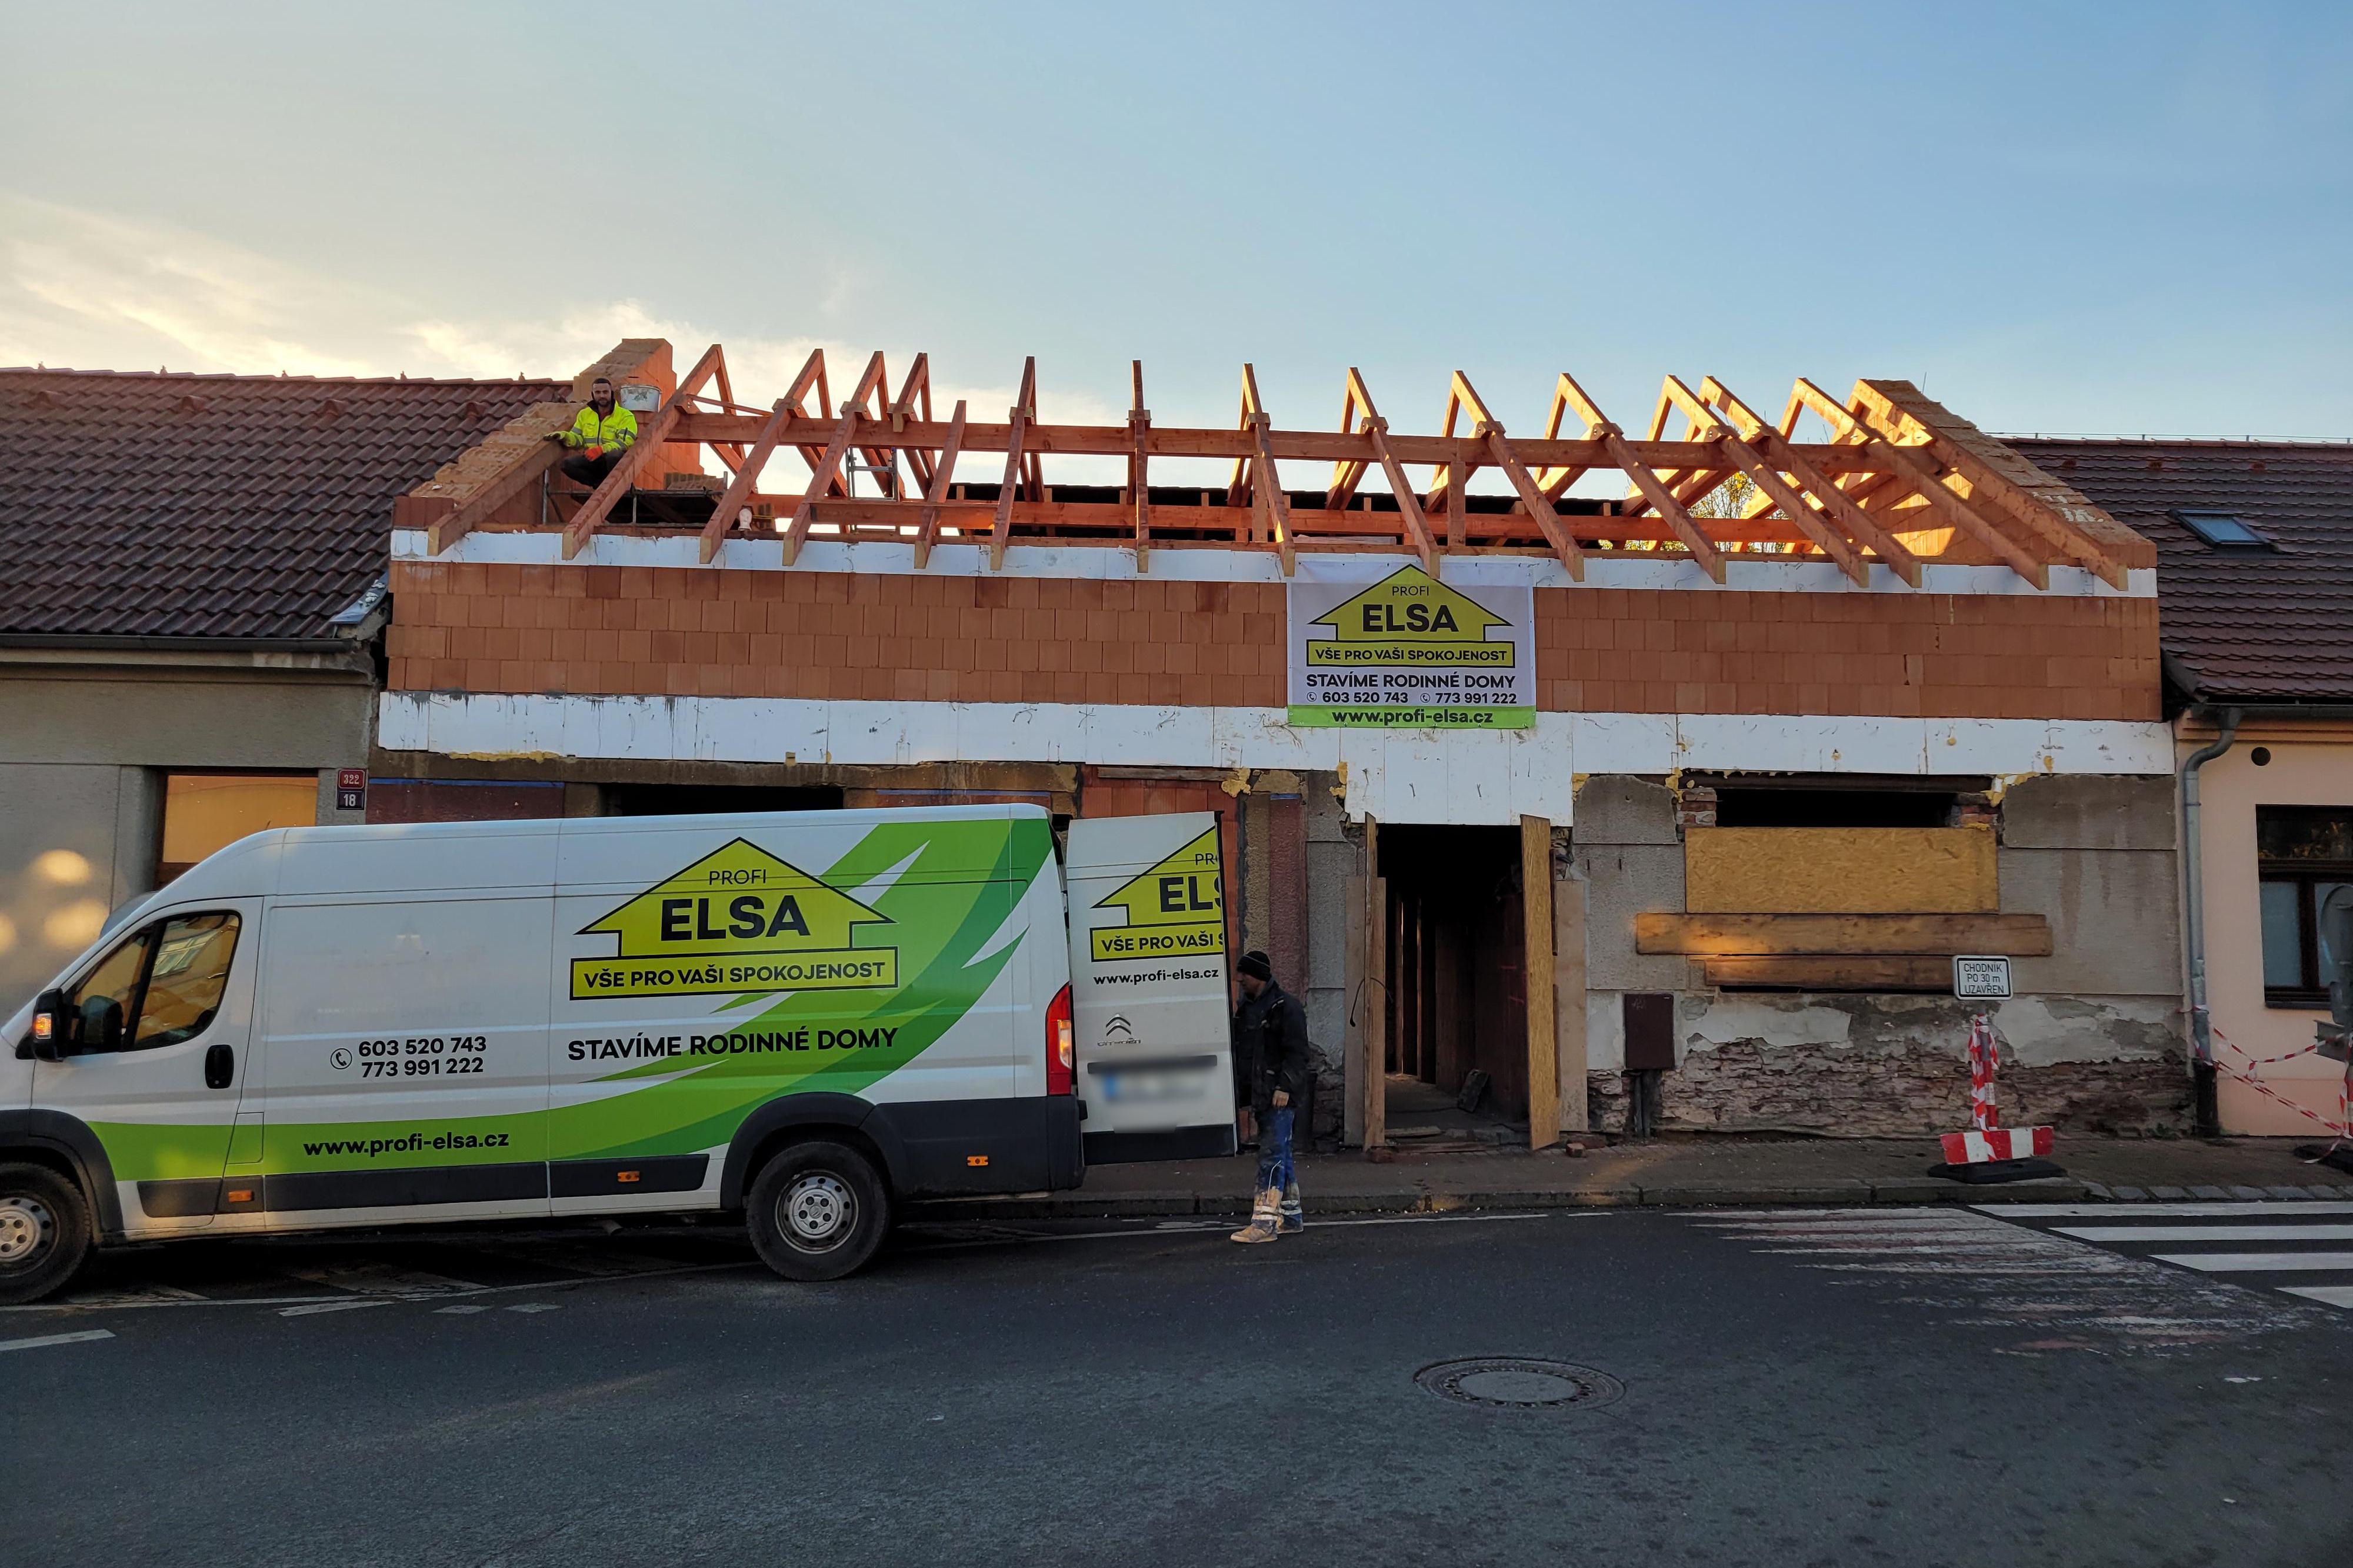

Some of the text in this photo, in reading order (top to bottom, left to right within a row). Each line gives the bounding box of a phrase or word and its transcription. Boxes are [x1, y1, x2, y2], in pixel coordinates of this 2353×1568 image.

[1392, 586, 1429, 596] PROFI
[1362, 603, 1459, 632] ELSA
[1315, 647, 1507, 661] VŠE PRO VAŠI SPOKOJENOST
[1307, 672, 1515, 688] STAVÍME RODINNÉ DOMY
[1322, 692, 1517, 704] 603 520 743 773 991 222
[1332, 709, 1493, 725] www.profi-elsa.cz
[344, 775, 359, 784] 322
[344, 794, 356, 806] 18
[1195, 853, 1217, 865] PR
[709, 869, 766, 886] PROFI
[1159, 876, 1221, 912] EL
[661, 895, 811, 941] ELSA
[1101, 935, 1134, 952] VŠE
[1139, 936, 1174, 950] PRO
[1176, 930, 1214, 948] VAŠI
[584, 962, 885, 988] VŠE PRO VAŠI SPOKOJENOST
[1094, 968, 1219, 985] www.profi-elsa.cz
[1967, 974, 1978, 982] PO
[1981, 974, 1990, 982] 30
[1965, 983, 2004, 993] UZAVŘEN
[358, 1036, 486, 1057] 603 520 743
[568, 1025, 898, 1061] STAVÍME RODINNÉ DOMY
[361, 1057, 484, 1078] 773 991 222
[303, 1132, 509, 1157] www.profi-elsa.cz
